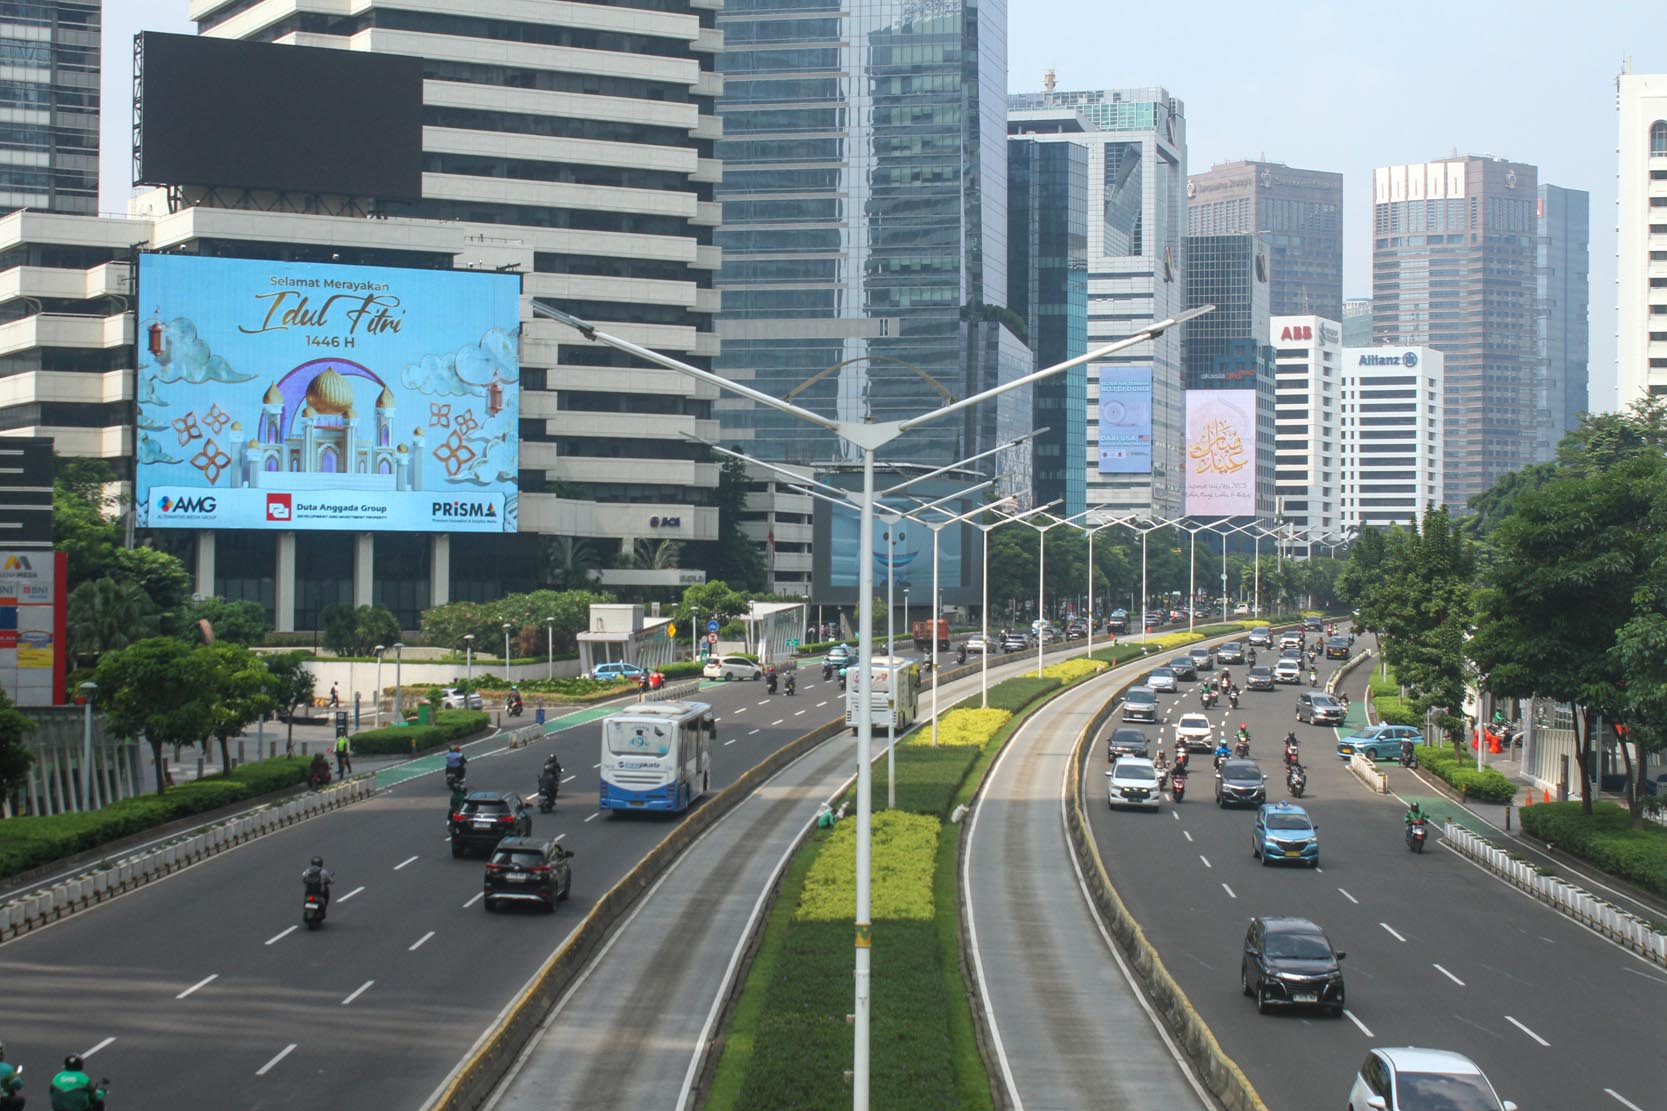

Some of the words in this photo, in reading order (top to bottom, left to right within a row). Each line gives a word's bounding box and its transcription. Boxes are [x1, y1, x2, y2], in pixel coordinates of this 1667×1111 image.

[270, 276, 320, 288] Selamat
[324, 278, 389, 292] Merayakan
[238, 291, 341, 334] Idul
[346, 293, 407, 336] Fitri
[1280, 326, 1312, 340] ABB
[306, 335, 340, 348] 1446
[344, 336, 355, 348] H
[1358, 354, 1400, 366] Allianz
[172, 496, 216, 513] AMG
[320, 504, 358, 513] Anggada
[361, 504, 387, 514] Group
